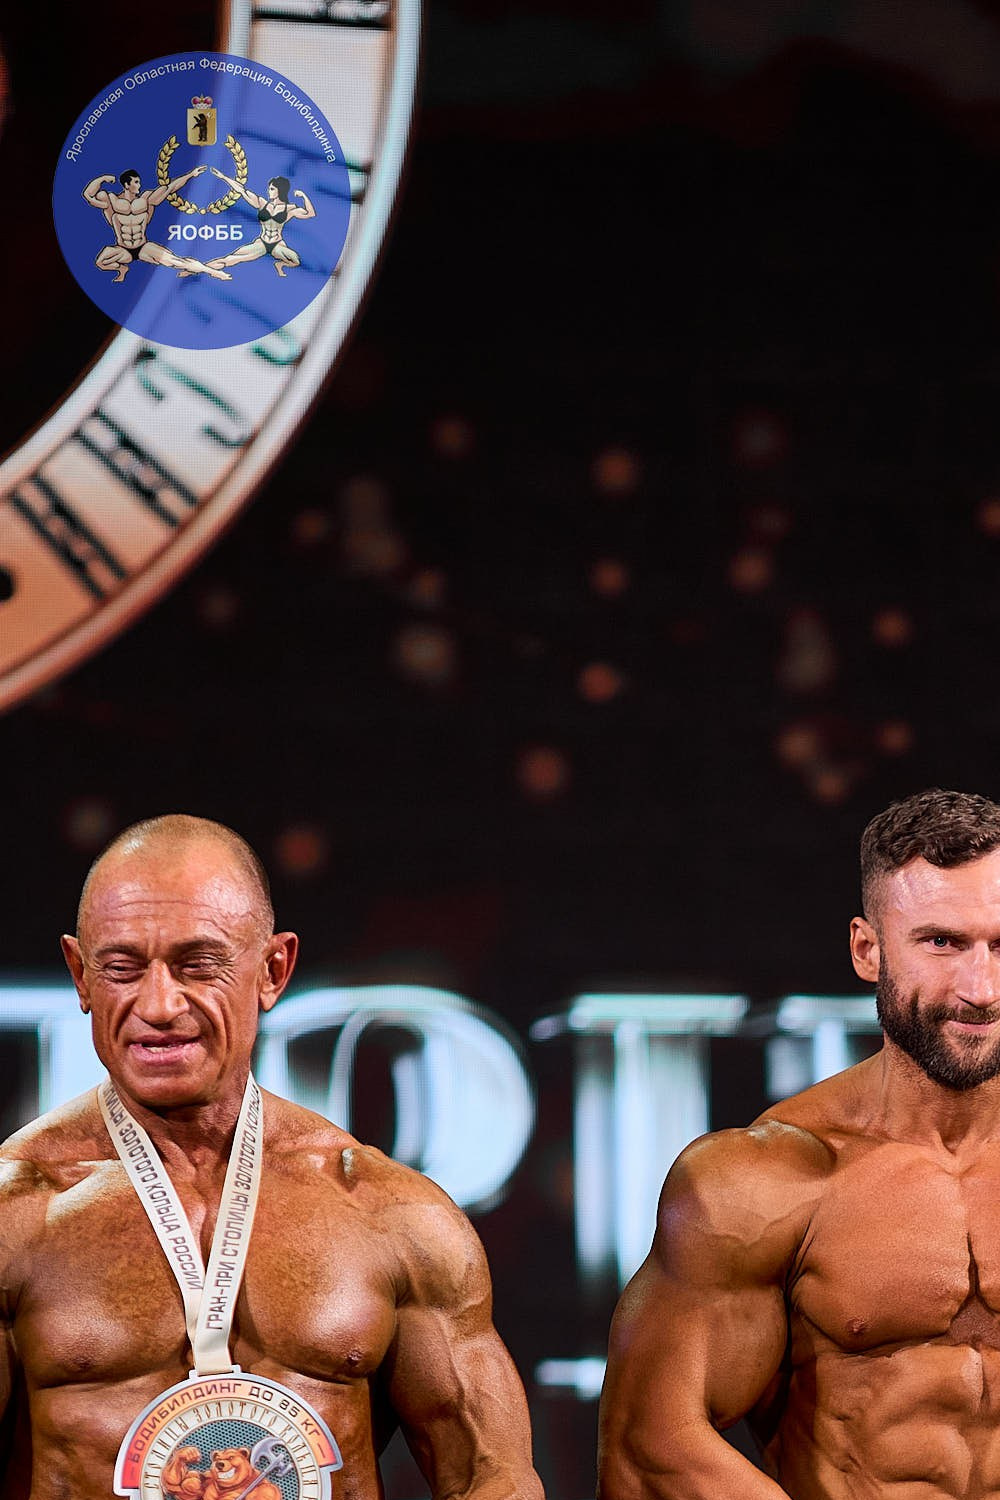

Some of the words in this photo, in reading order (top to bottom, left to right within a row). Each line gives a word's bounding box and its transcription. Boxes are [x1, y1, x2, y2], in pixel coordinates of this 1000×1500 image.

[235, 1130, 256, 1189] ЗОЛОТОГО
[119, 1122, 158, 1183] ЗОЛОТОГО
[146, 1181, 181, 1233] КОЛЬЦА
[169, 1236, 203, 1290] РОССИИ
[223, 1191, 249, 1257] СТОЛИЦЫ
[206, 1260, 236, 1330] ГРАН-ПРИ
[132, 1383, 242, 1464] БОДИБИЛДИНГ
[248, 1386, 274, 1402] ДО
[279, 1398, 301, 1417] 85
[300, 1419, 322, 1438] КГ
